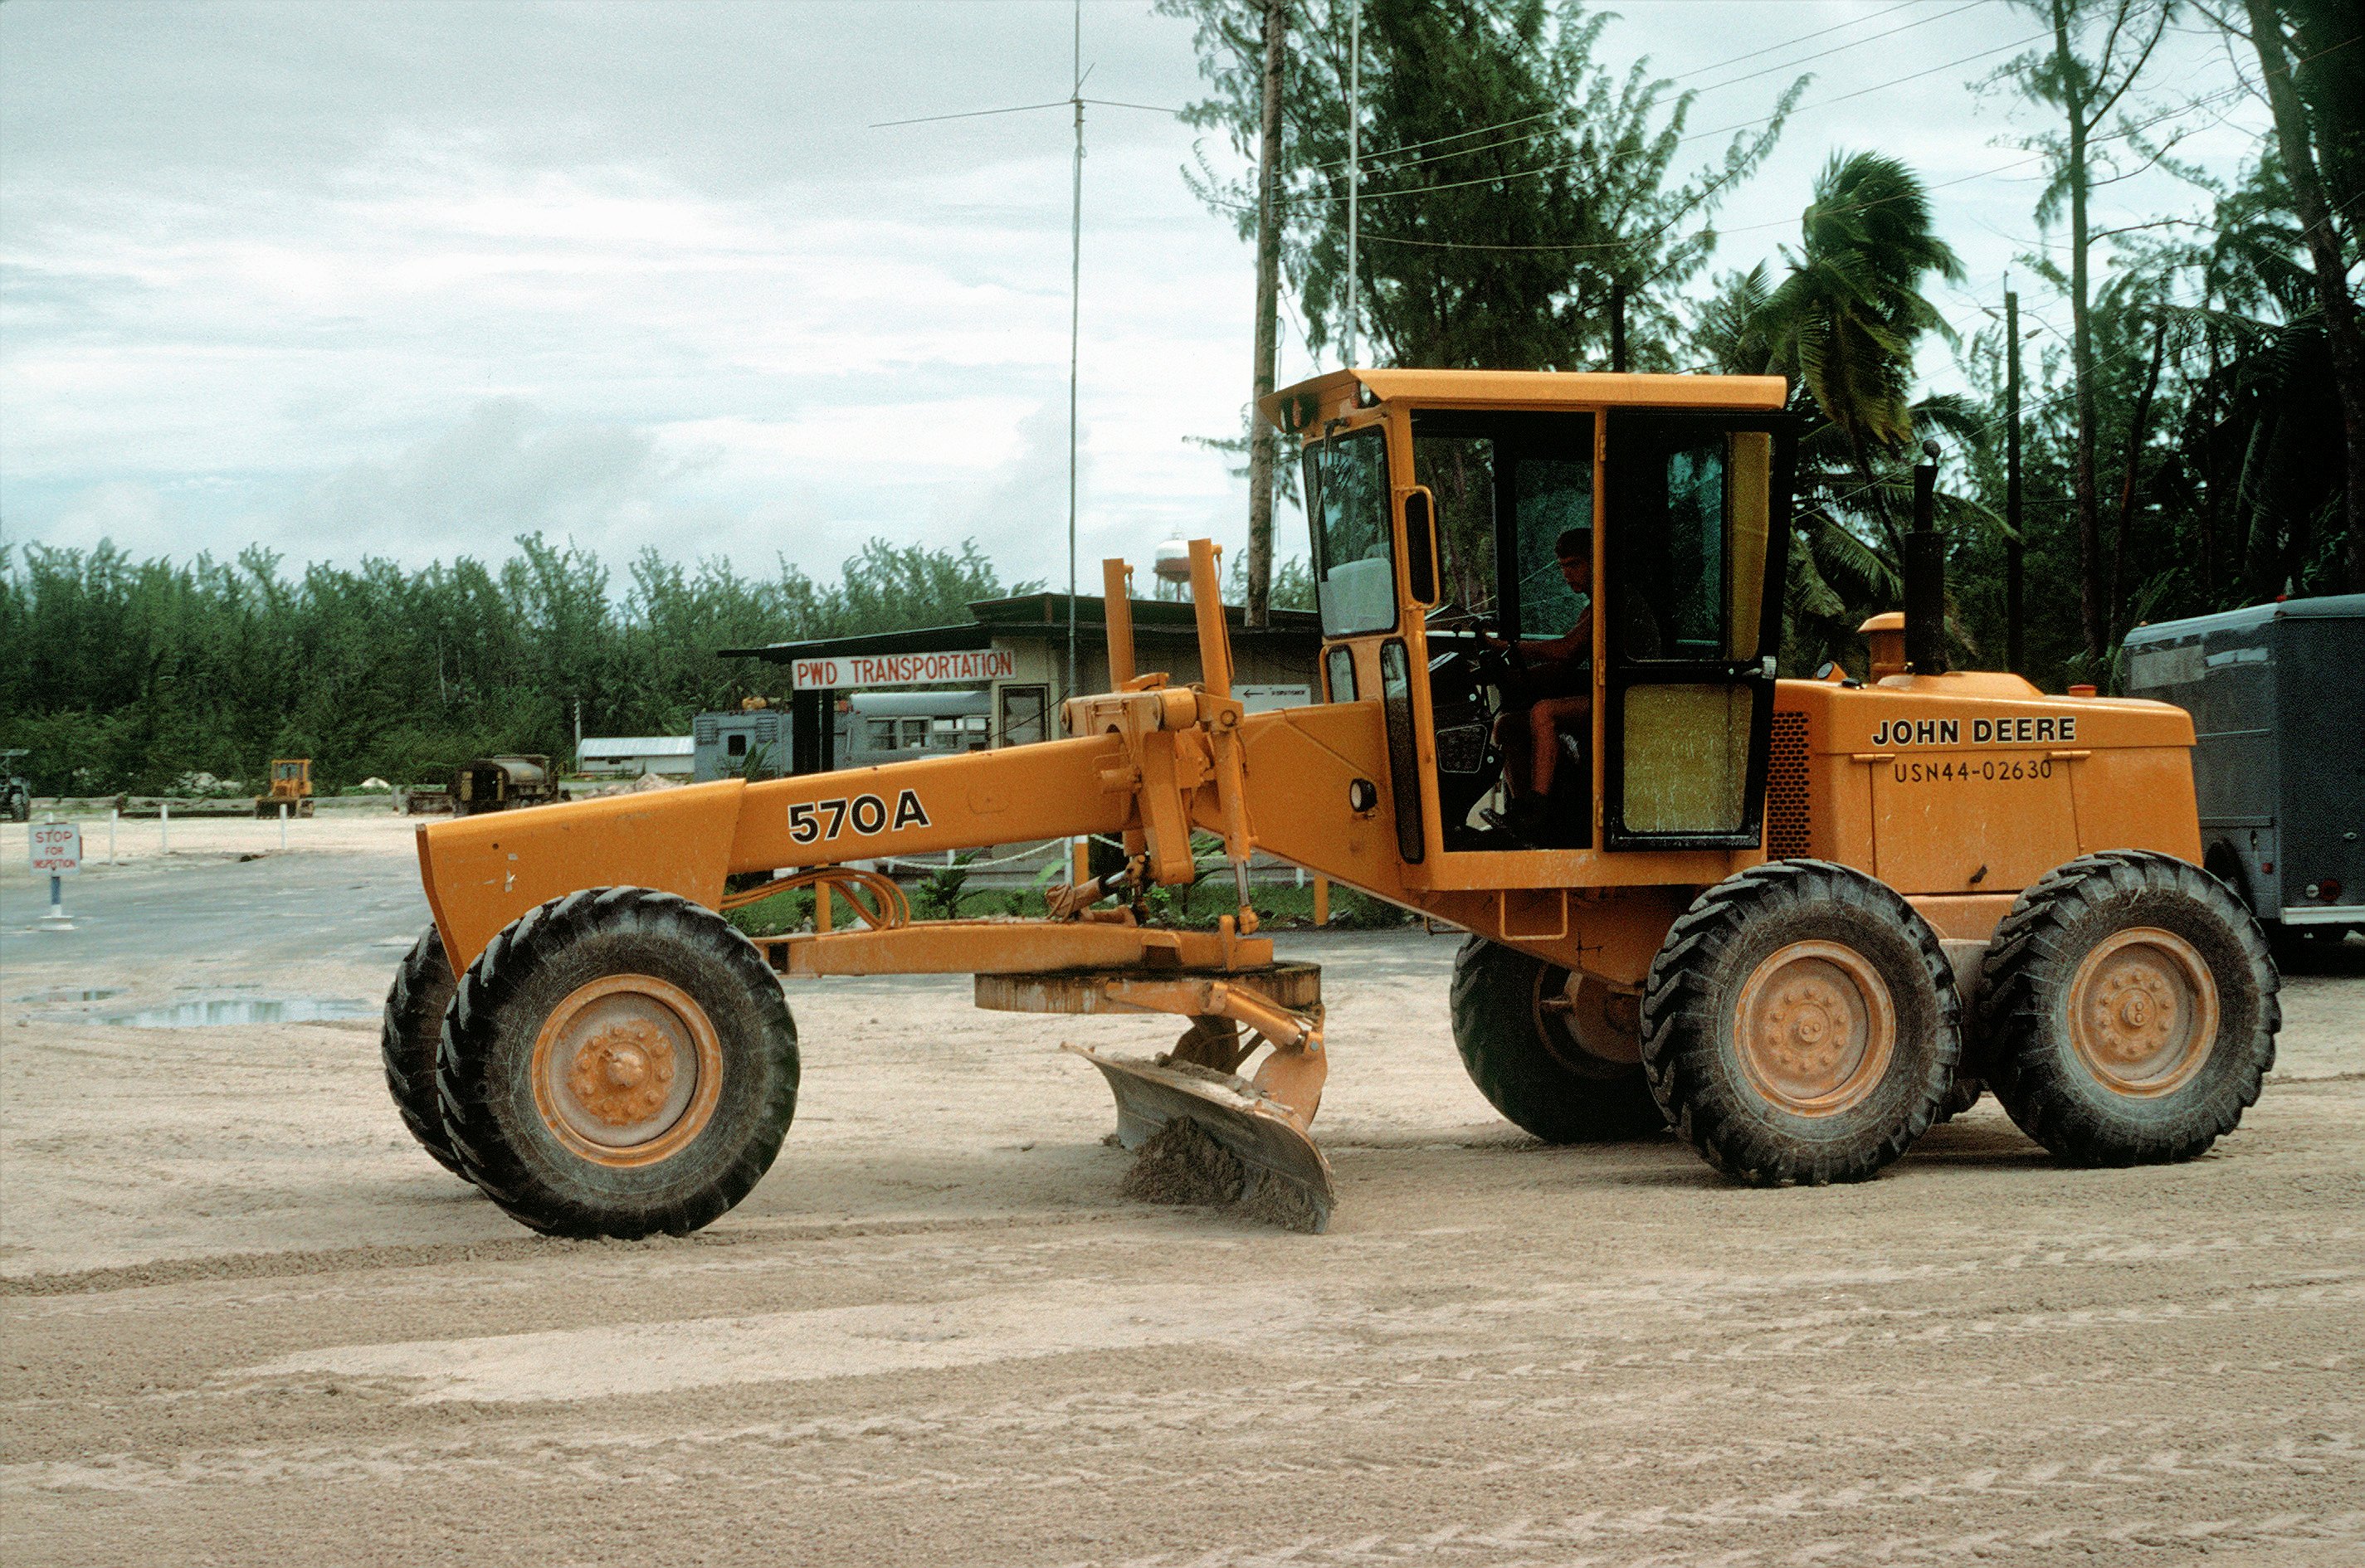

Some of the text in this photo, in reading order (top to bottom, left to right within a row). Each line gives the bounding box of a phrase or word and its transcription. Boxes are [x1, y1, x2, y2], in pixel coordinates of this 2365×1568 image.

[797, 650, 1013, 686] PWD TRANSPORTATION
[1872, 716, 2076, 747] JOHN DEERE
[1894, 760, 2053, 783] USN44-02630
[788, 788, 932, 845] 570A
[36, 830, 72, 843] STOP
[45, 847, 64, 855] FOR
[34, 859, 76, 869] INSPECTION
